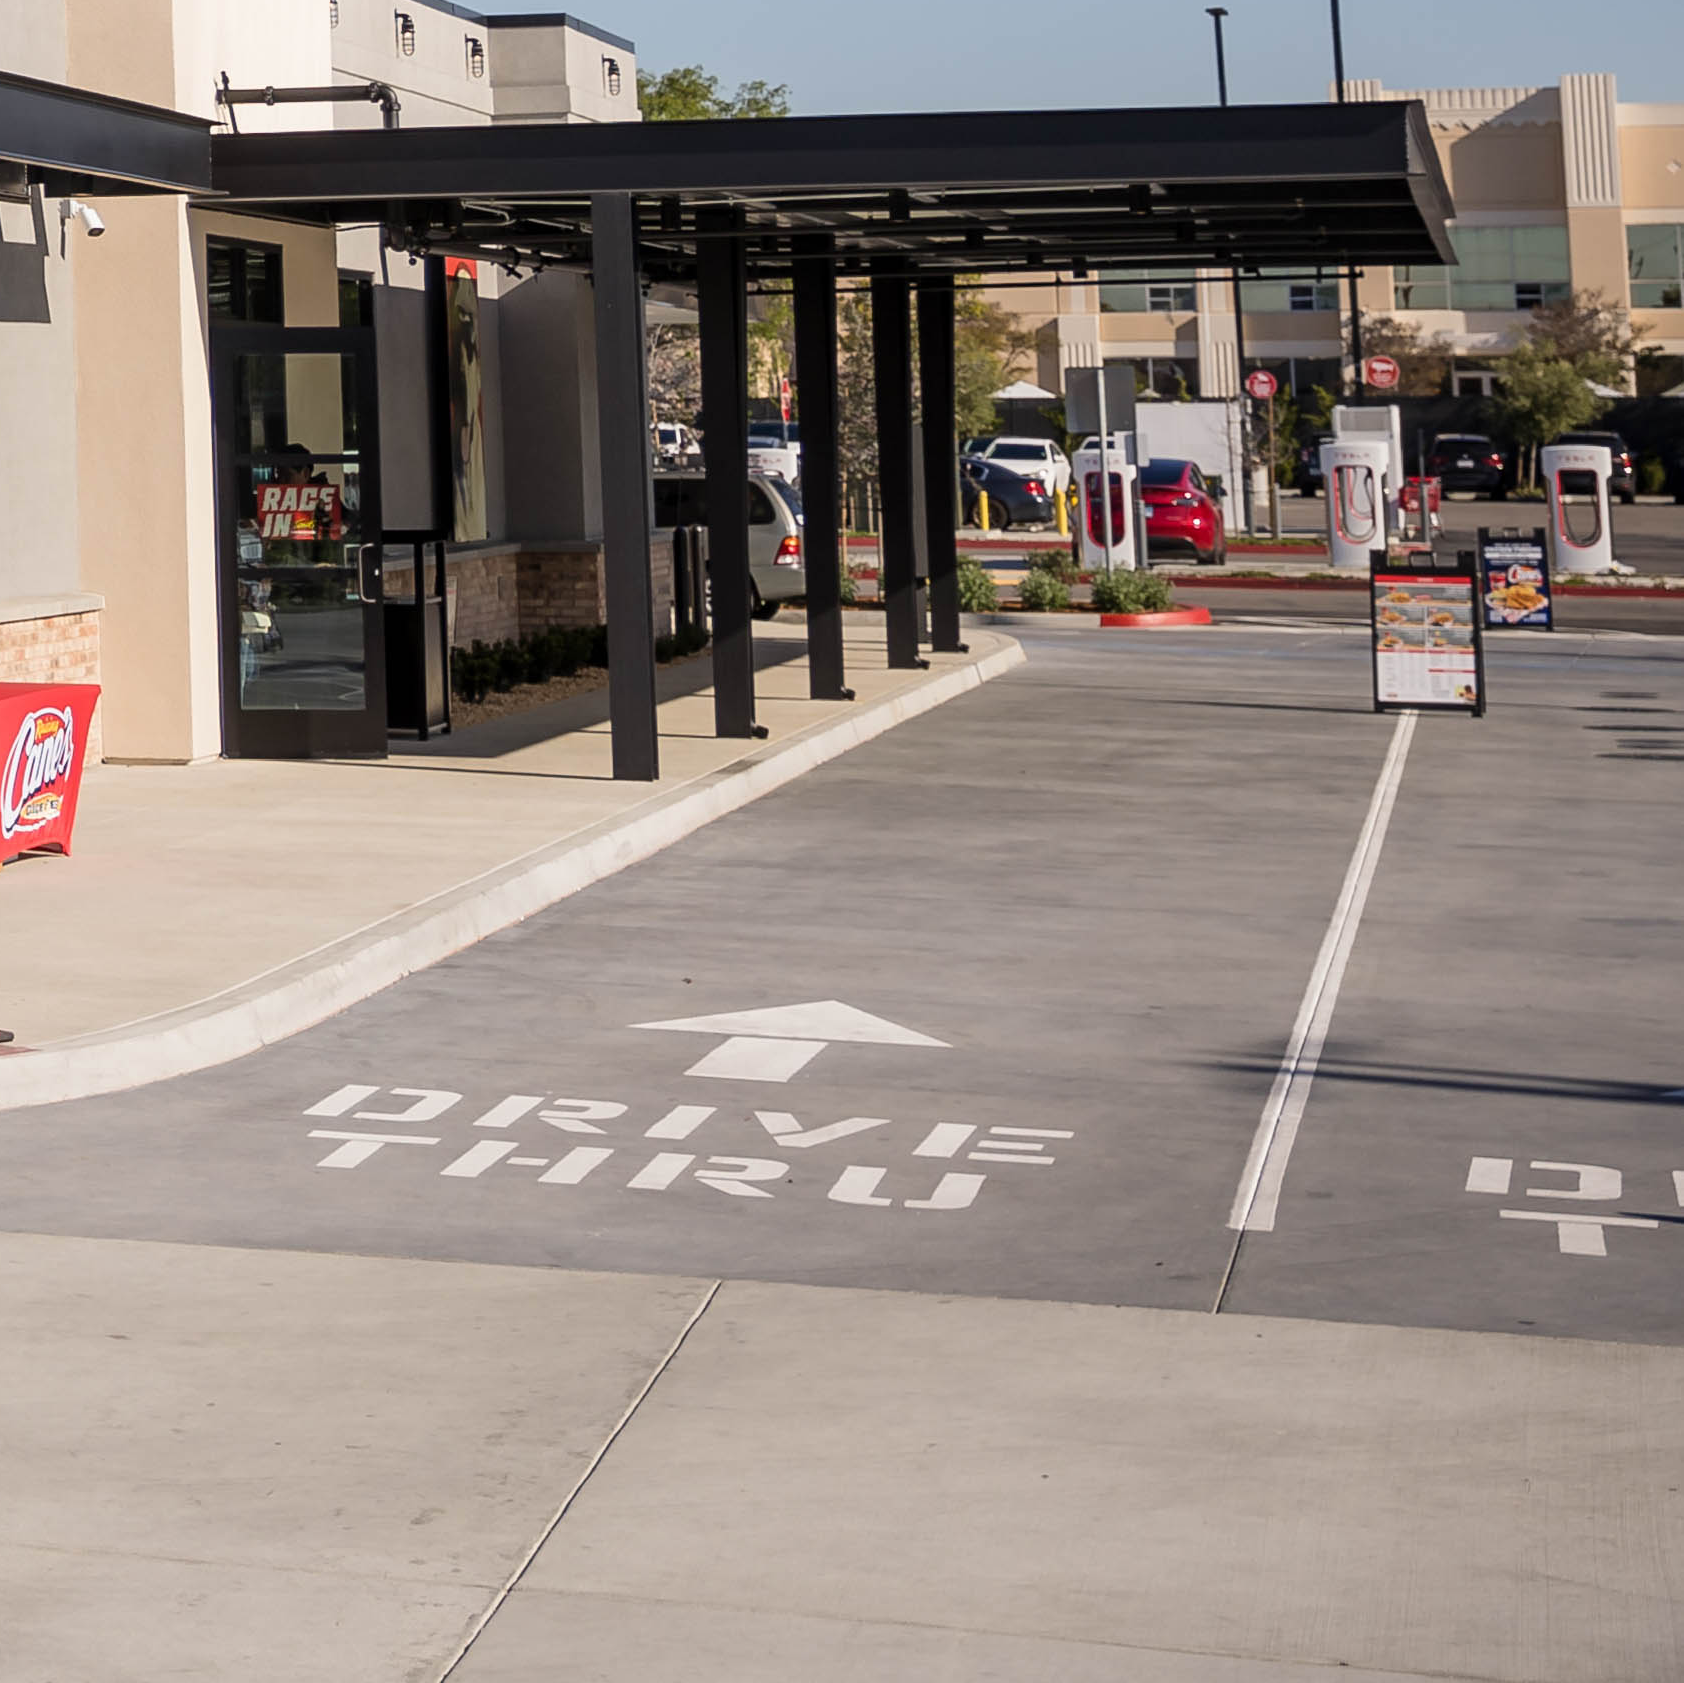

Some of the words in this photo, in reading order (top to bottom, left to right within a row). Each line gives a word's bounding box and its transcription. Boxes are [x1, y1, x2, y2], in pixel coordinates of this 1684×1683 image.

[261, 513, 293, 538] IN
[302, 1083, 1075, 1165] DRIVE
[307, 1129, 987, 1211] THRU
[1465, 1156, 1684, 1207] D
